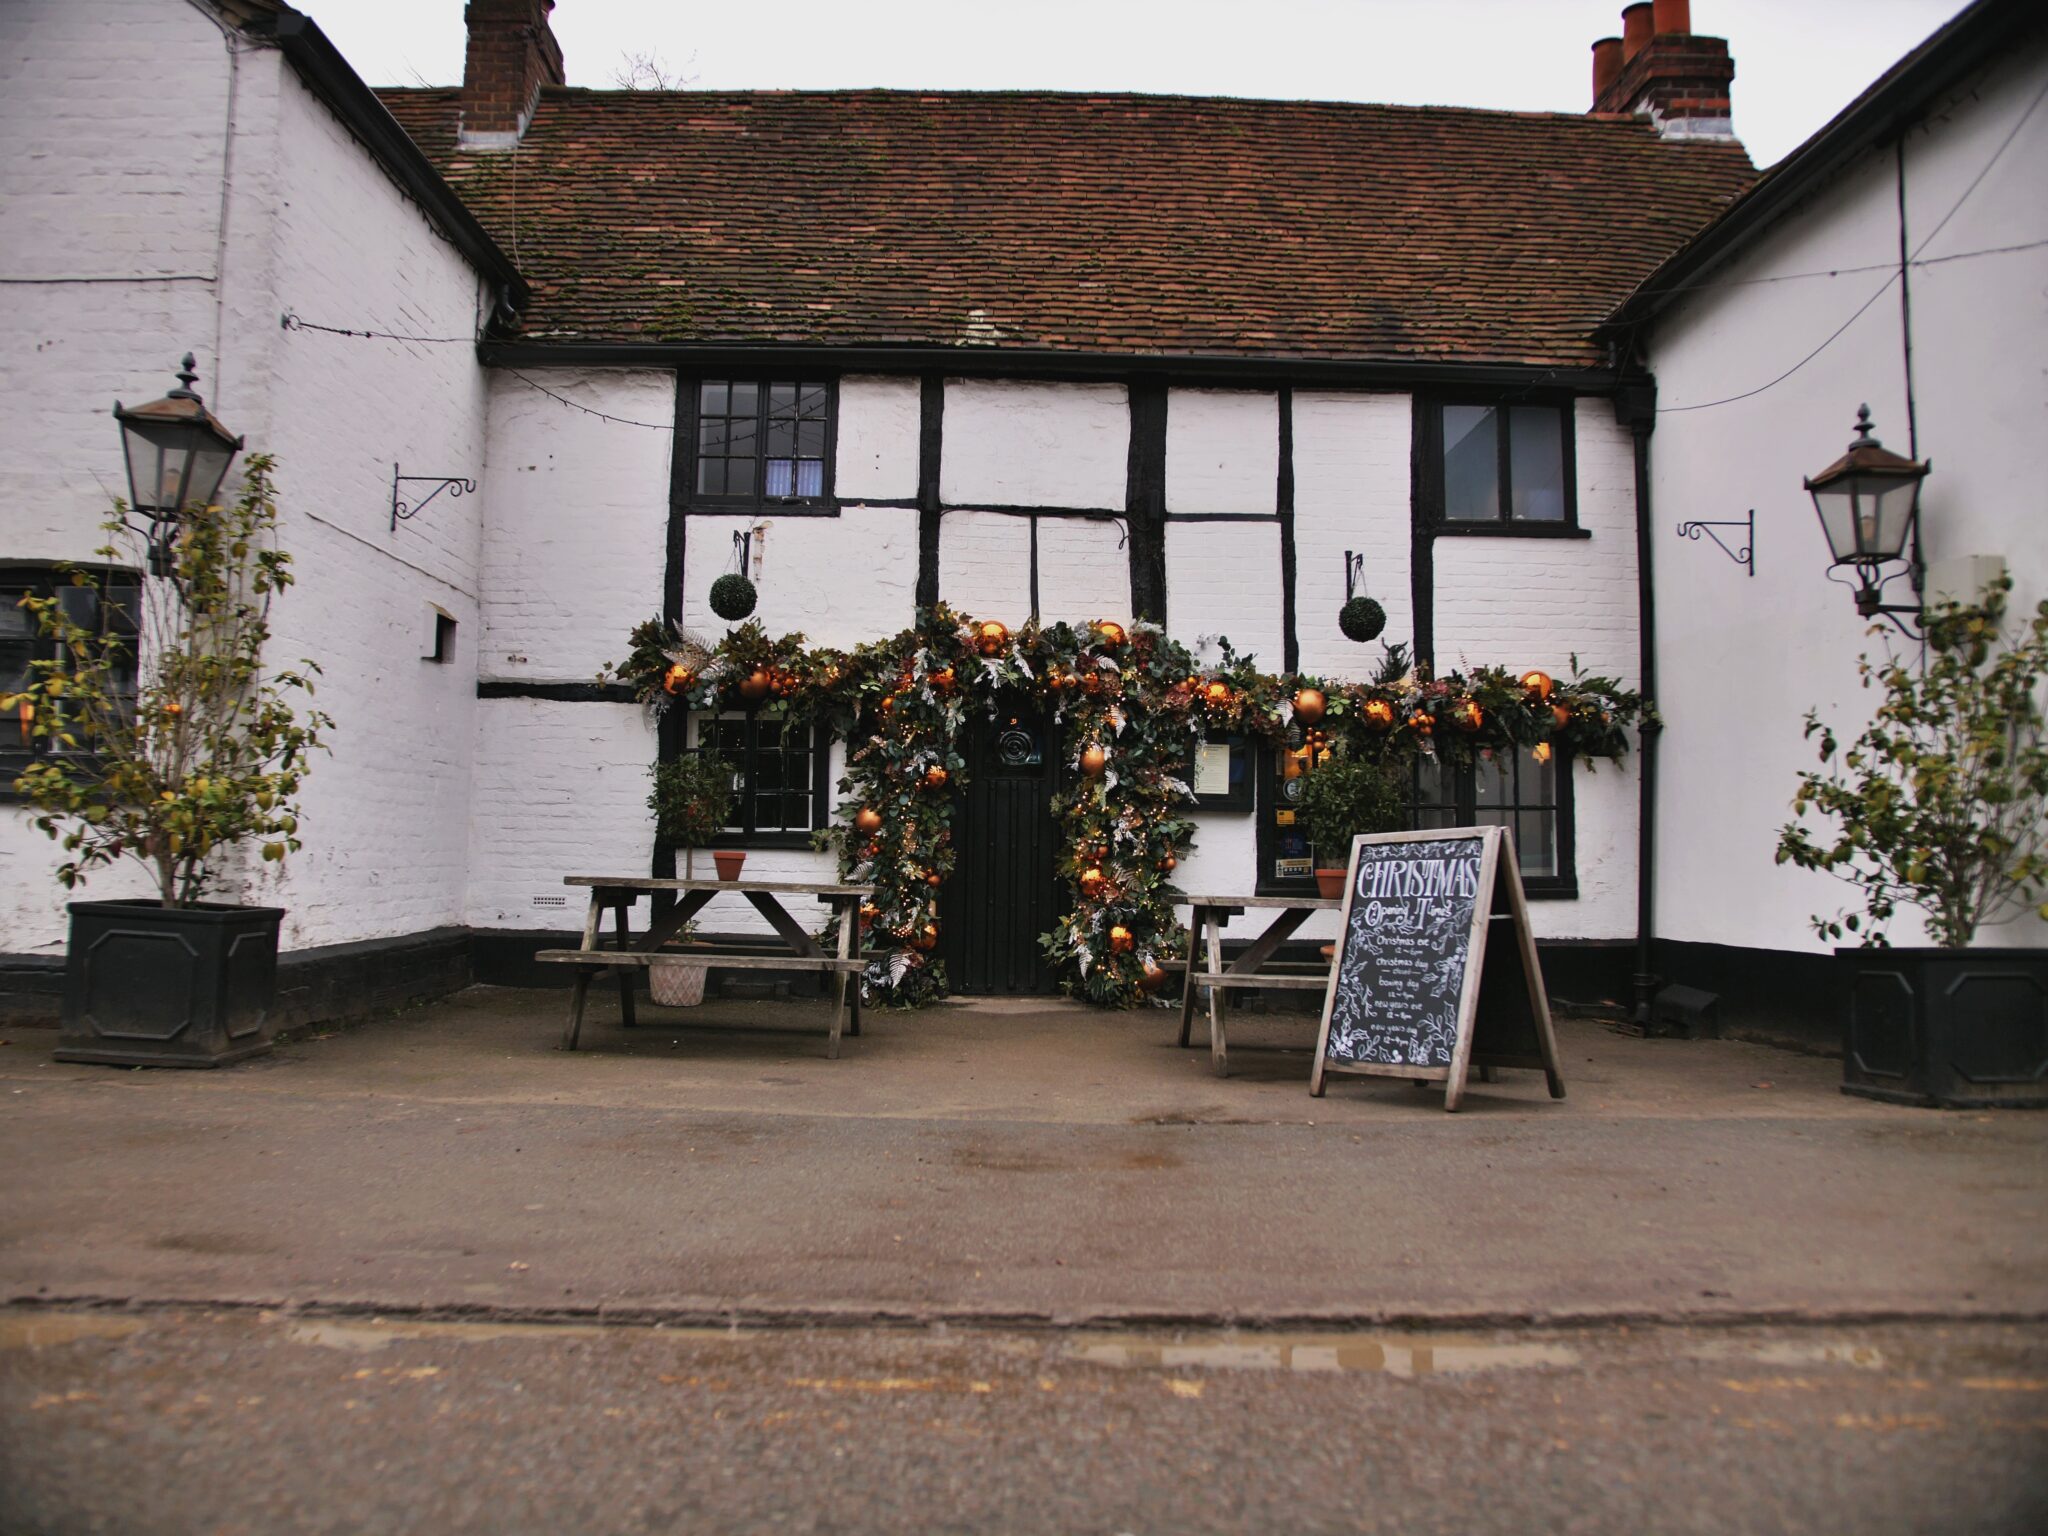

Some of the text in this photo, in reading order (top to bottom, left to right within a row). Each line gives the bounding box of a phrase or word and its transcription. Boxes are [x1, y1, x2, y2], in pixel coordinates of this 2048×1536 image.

[1357, 857, 1481, 900] CHRISTMAS
[1365, 898, 1452, 929] Opening Times
